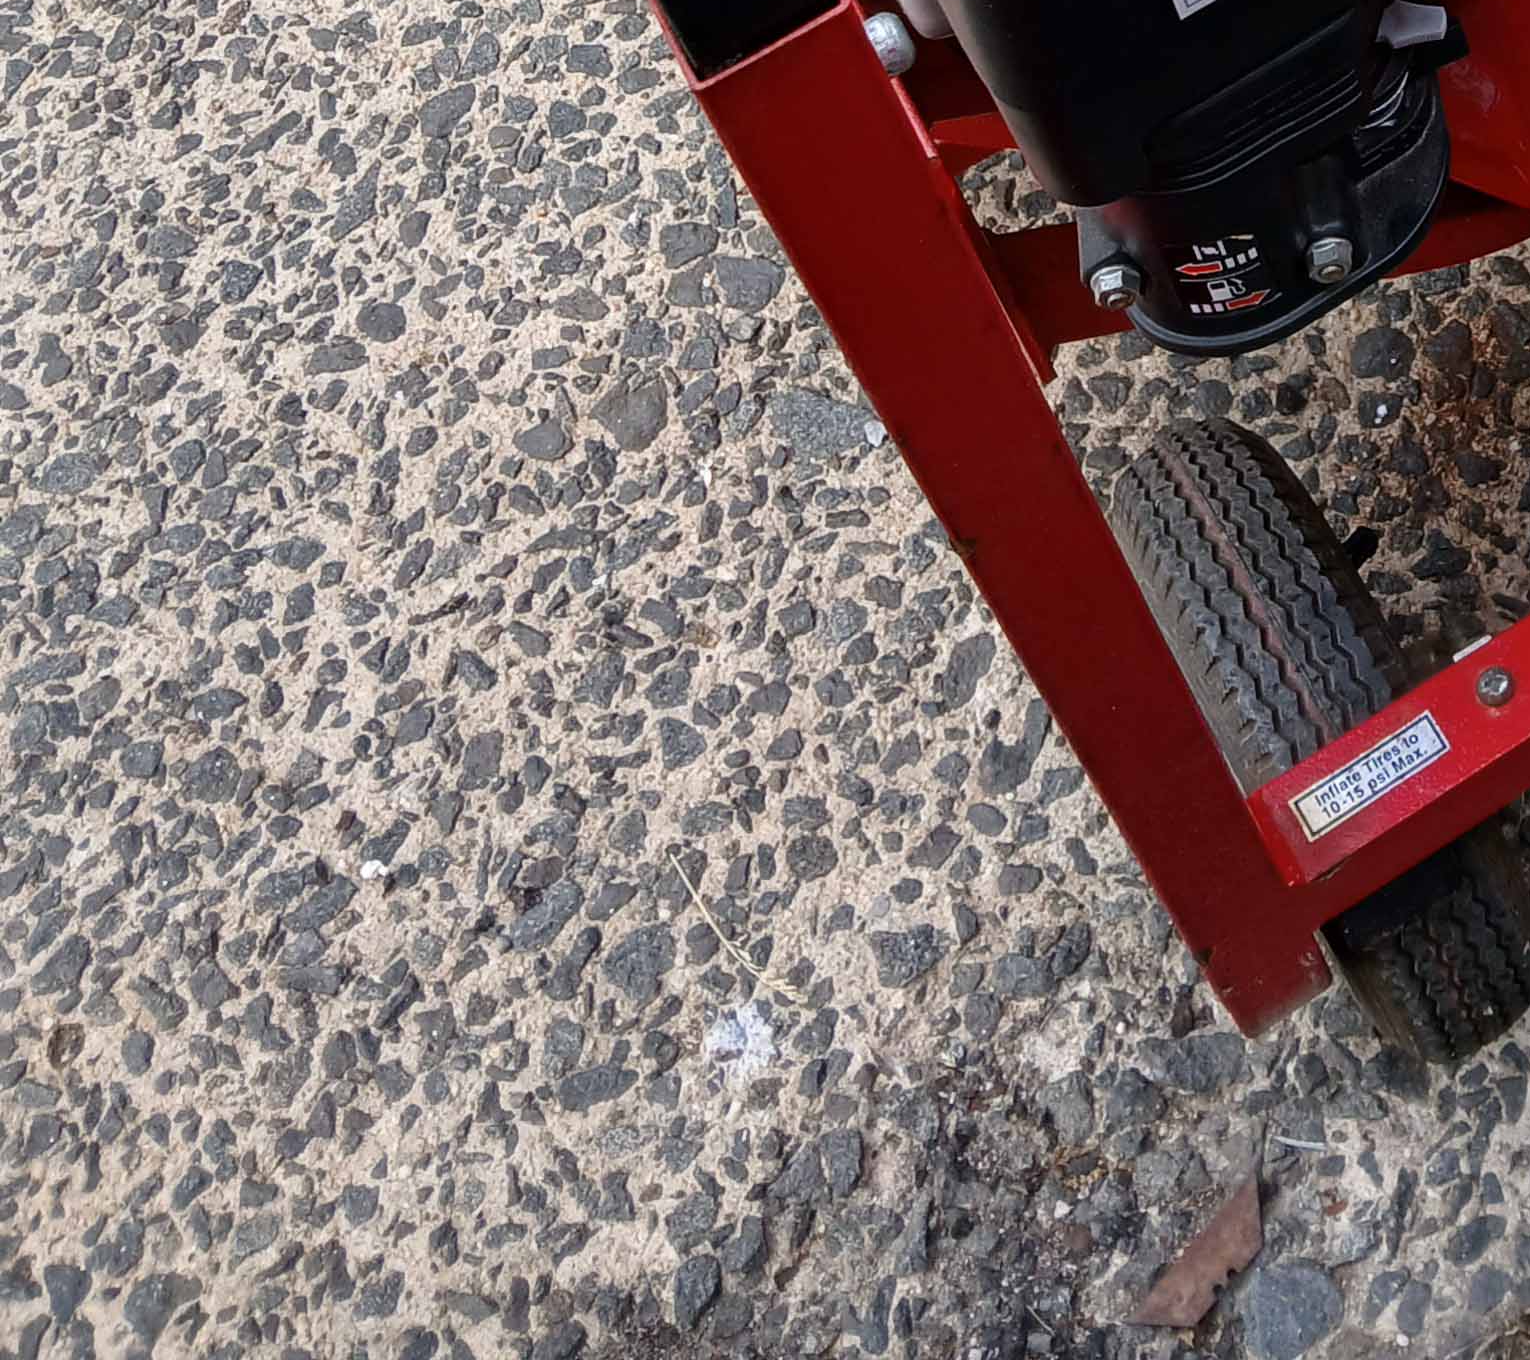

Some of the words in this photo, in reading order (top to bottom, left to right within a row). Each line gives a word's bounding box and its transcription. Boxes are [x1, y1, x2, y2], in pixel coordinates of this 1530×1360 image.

[1314, 772, 1362, 806] Inflate
[1362, 745, 1401, 772] Tires
[1402, 734, 1419, 748] to
[1367, 767, 1395, 795] psi
[1391, 747, 1428, 773] Max.
